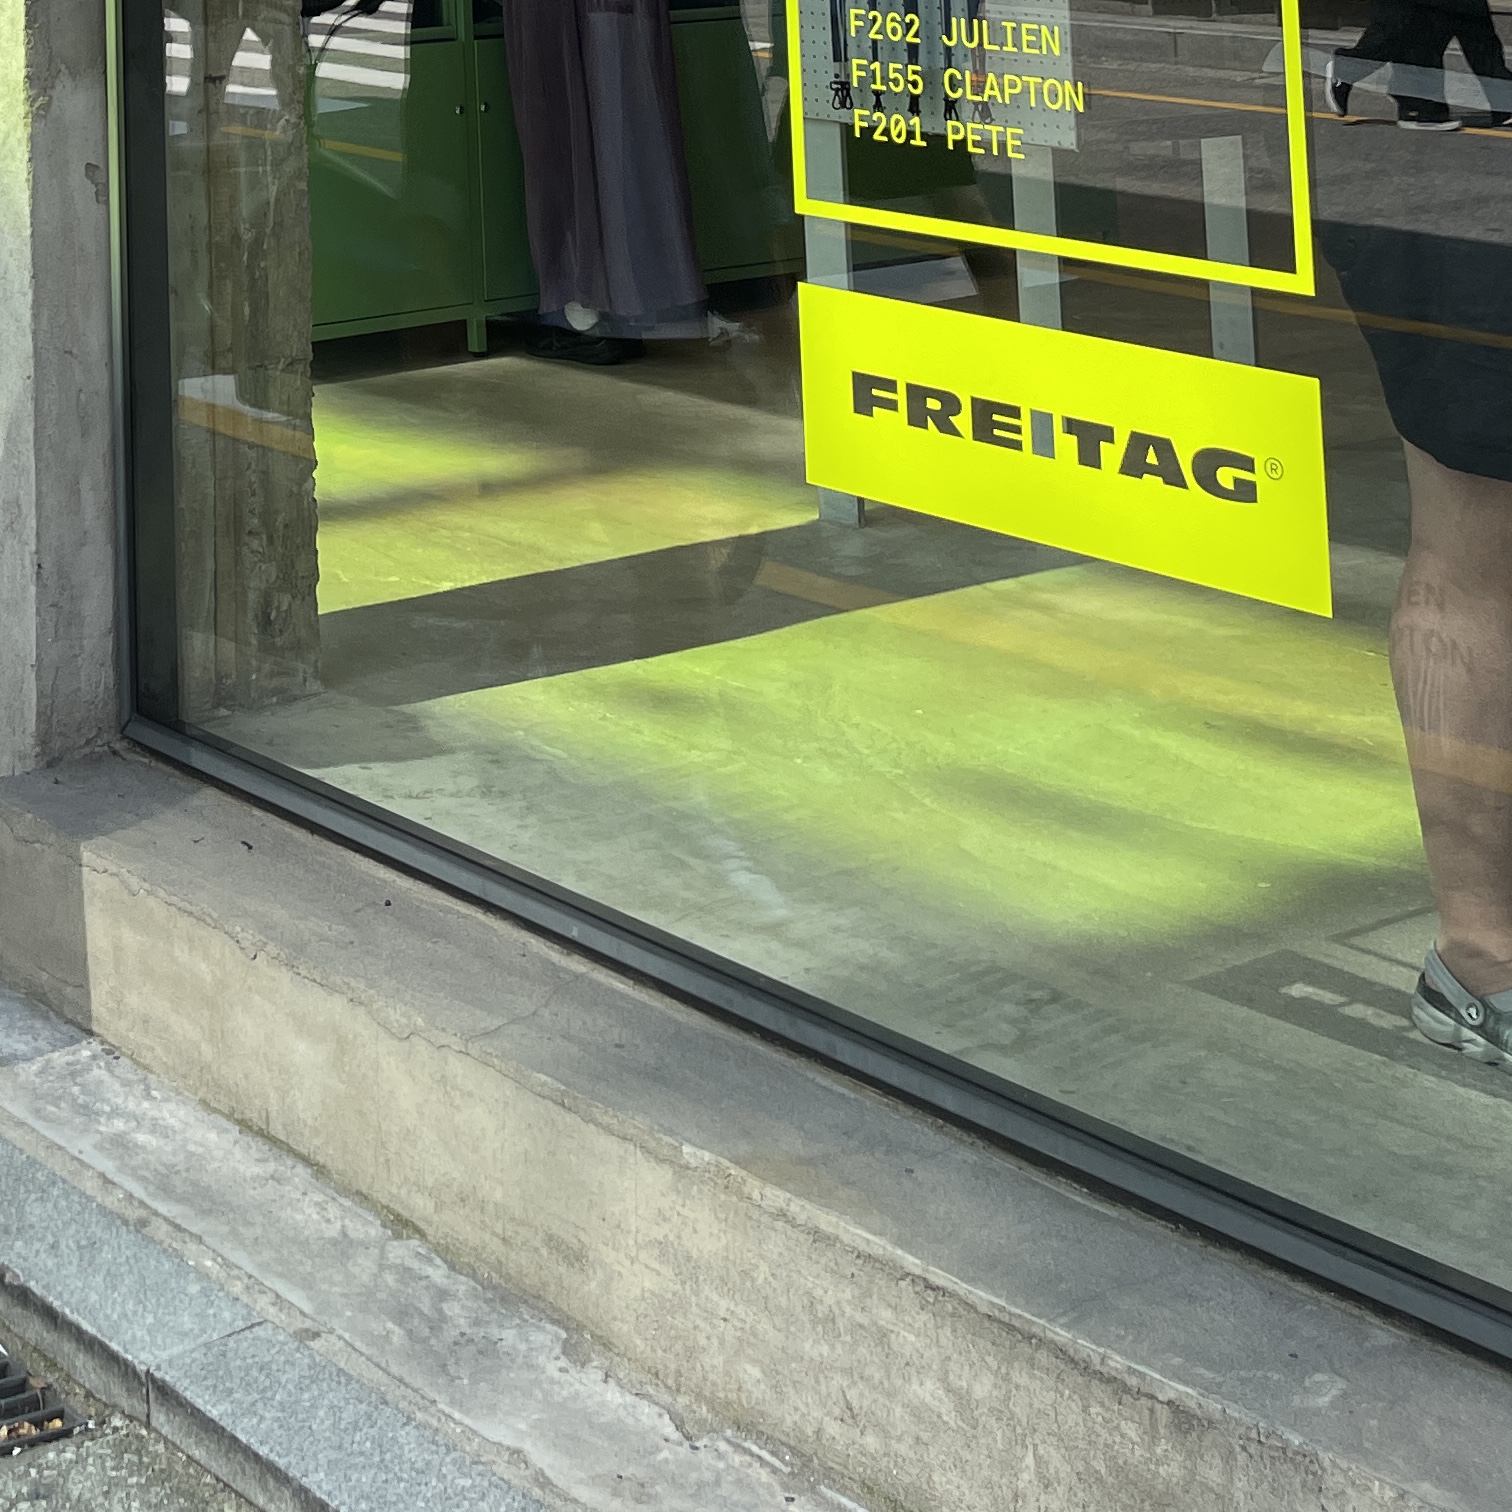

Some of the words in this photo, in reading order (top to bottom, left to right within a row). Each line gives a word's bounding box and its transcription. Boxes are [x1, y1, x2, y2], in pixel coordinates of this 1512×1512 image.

[849, 9, 920, 44] F262
[941, 18, 1061, 57] JULIEN
[851, 59, 924, 96] F155
[943, 69, 1085, 113] CLAPTON
[853, 108, 928, 148] F201
[946, 120, 1025, 160] PETE
